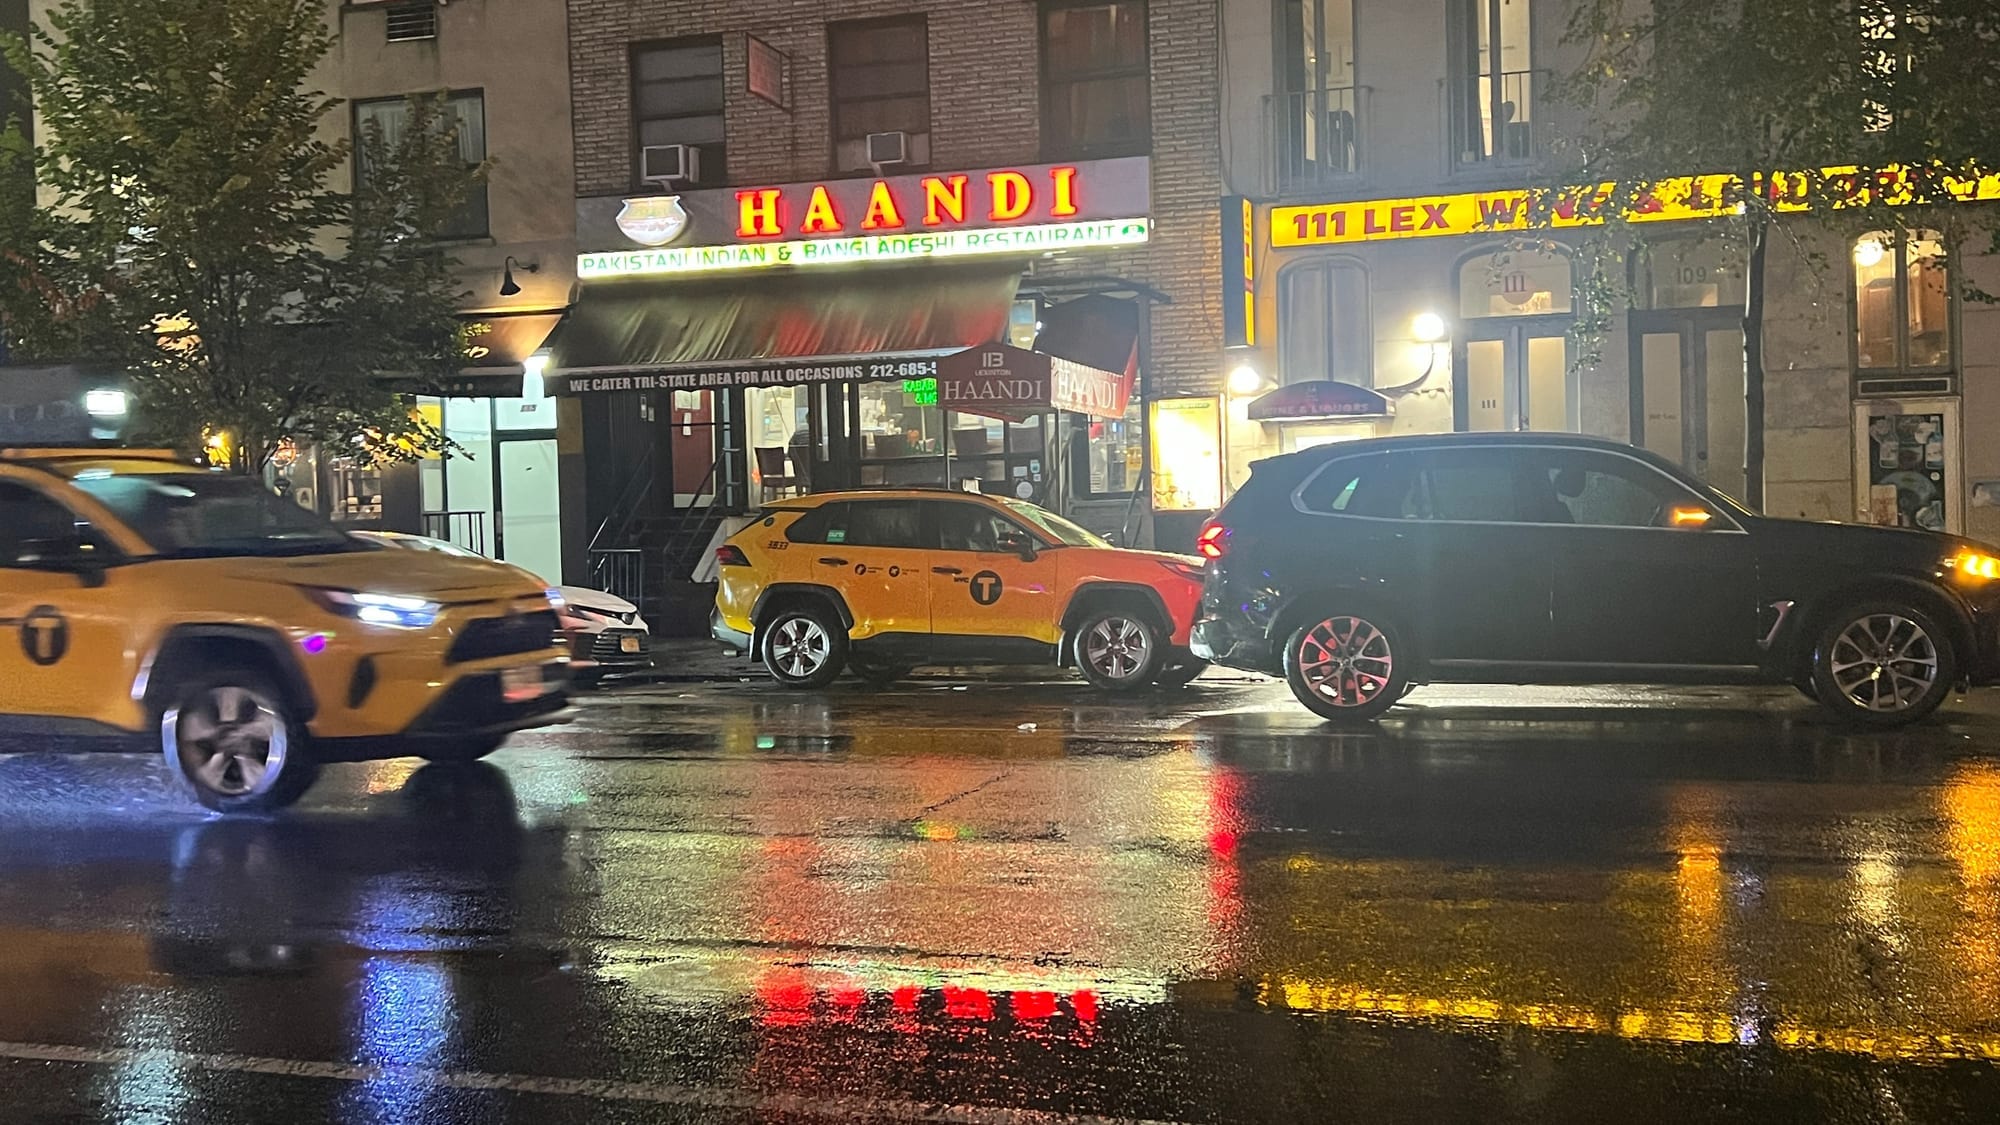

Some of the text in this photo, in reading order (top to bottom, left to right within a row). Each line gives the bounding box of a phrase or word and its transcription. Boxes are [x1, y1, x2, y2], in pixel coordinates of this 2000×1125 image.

[735, 166, 1077, 238] HAANDI
[1293, 211, 1346, 239] 111
[1363, 203, 1450, 234] LEX
[582, 225, 1115, 271] PAKISTANI INDIAN & BANGLADESHI RESTAURANT
[1677, 267, 1707, 284] 109
[569, 379, 590, 392] WE
[592, 376, 631, 391] CATER
[634, 374, 697, 388] TRI-STATE
[700, 371, 732, 385] AREA
[735, 370, 759, 383] FOR
[762, 368, 783, 382] ALL
[786, 365, 863, 381] OCCASIONS
[944, 380, 1042, 400] HAANDI
[1057, 368, 1118, 411] HAANDI
